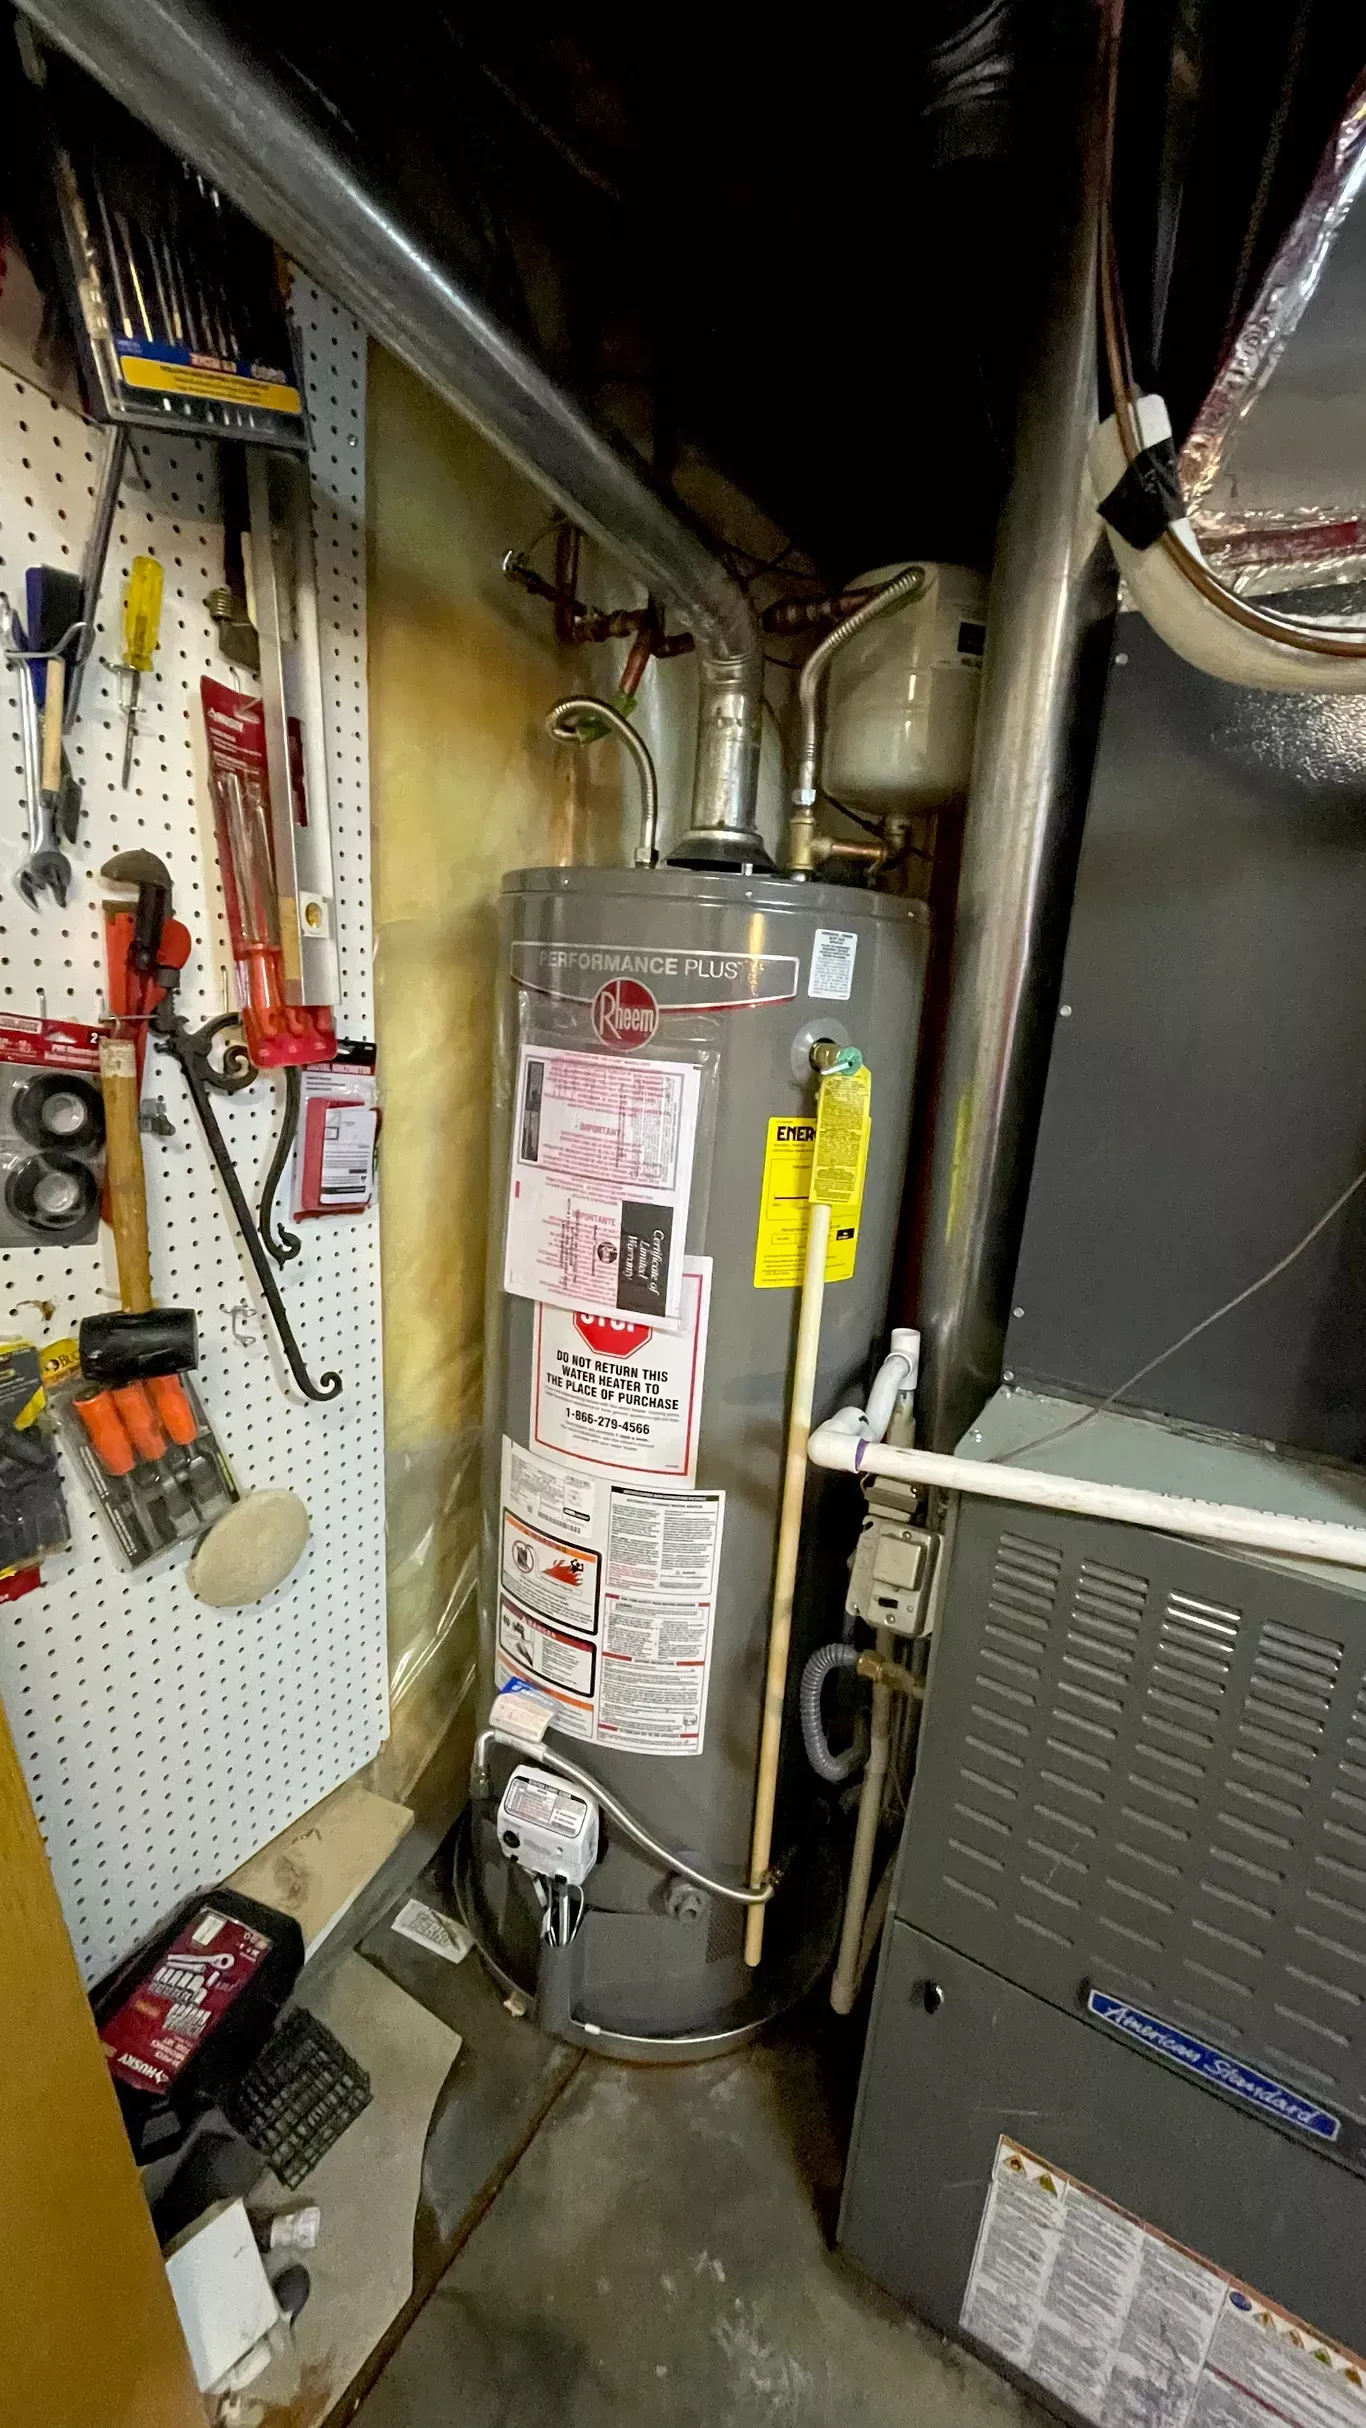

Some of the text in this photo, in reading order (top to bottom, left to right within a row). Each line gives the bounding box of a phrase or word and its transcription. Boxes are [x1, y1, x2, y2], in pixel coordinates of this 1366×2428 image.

[540, 950, 678, 975] PERFORMANCE
[599, 980, 653, 1040] Rheem
[777, 1125, 817, 1141] ENER
[572, 1209, 616, 1226] IMPORTANTE
[622, 1235, 638, 1280] Warranty
[638, 1240, 651, 1280] Limited
[649, 1229, 665, 1296] Certificate of
[557, 1349, 668, 1382] DO NOT RETURN THIS
[562, 1365, 660, 1395] WATER HEATER TO
[547, 1373, 563, 1388] THE
[566, 1380, 597, 1398] PLACE
[601, 1389, 615, 1401] OF
[618, 1393, 679, 1410] PURCHASE
[565, 1407, 650, 1435] 1-866-279-4566
[117, 2053, 157, 2079] HUSKY
[1104, 2006, 1320, 2124] American Standard
